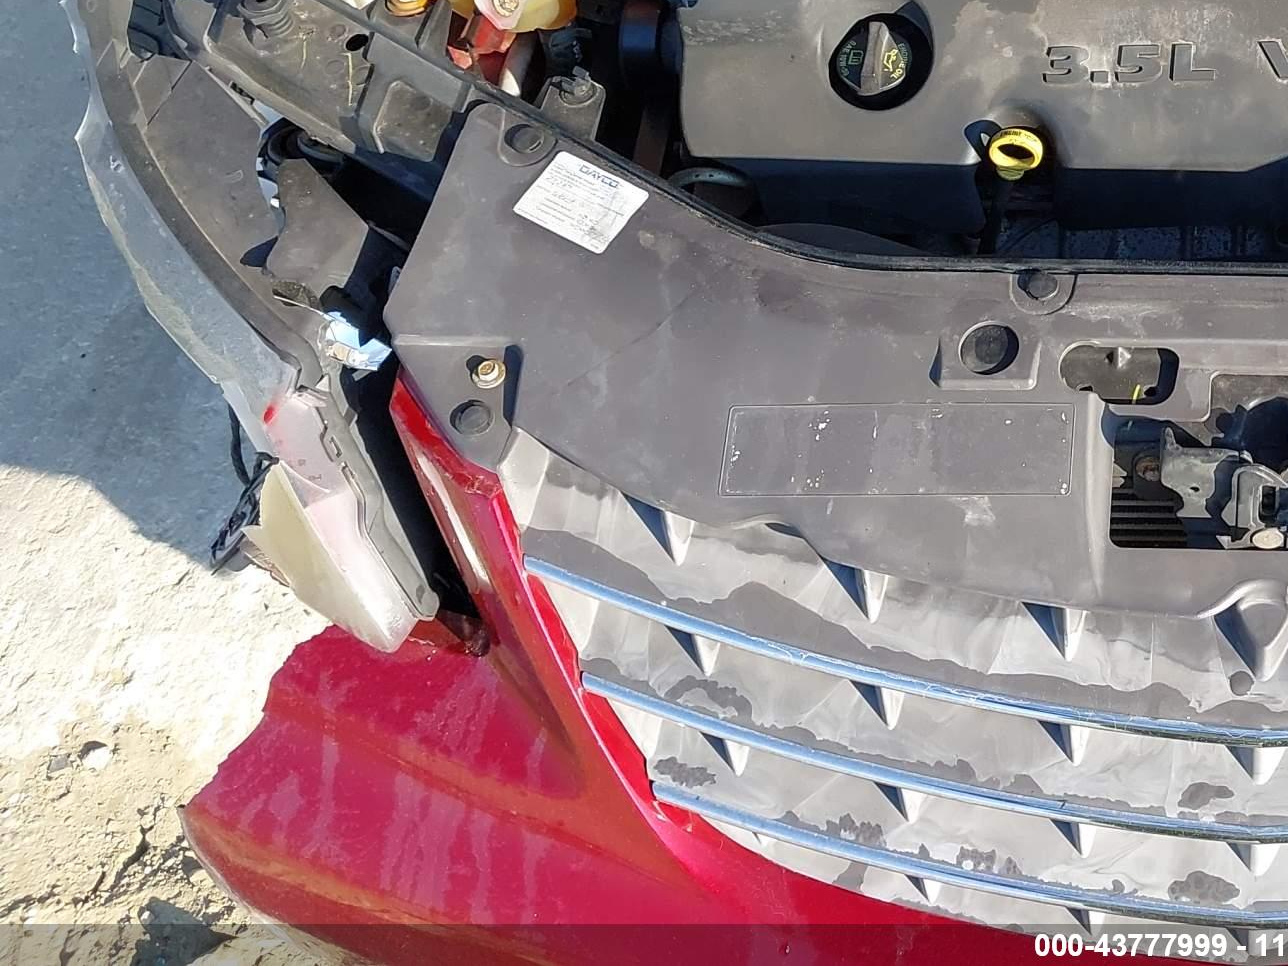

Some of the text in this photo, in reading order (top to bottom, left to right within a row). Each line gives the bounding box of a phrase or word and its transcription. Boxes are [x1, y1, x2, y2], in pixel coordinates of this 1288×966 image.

[890, 68, 903, 80] OIL
[1042, 44, 1216, 84] 3.5L
[579, 164, 619, 188] DAYCO
